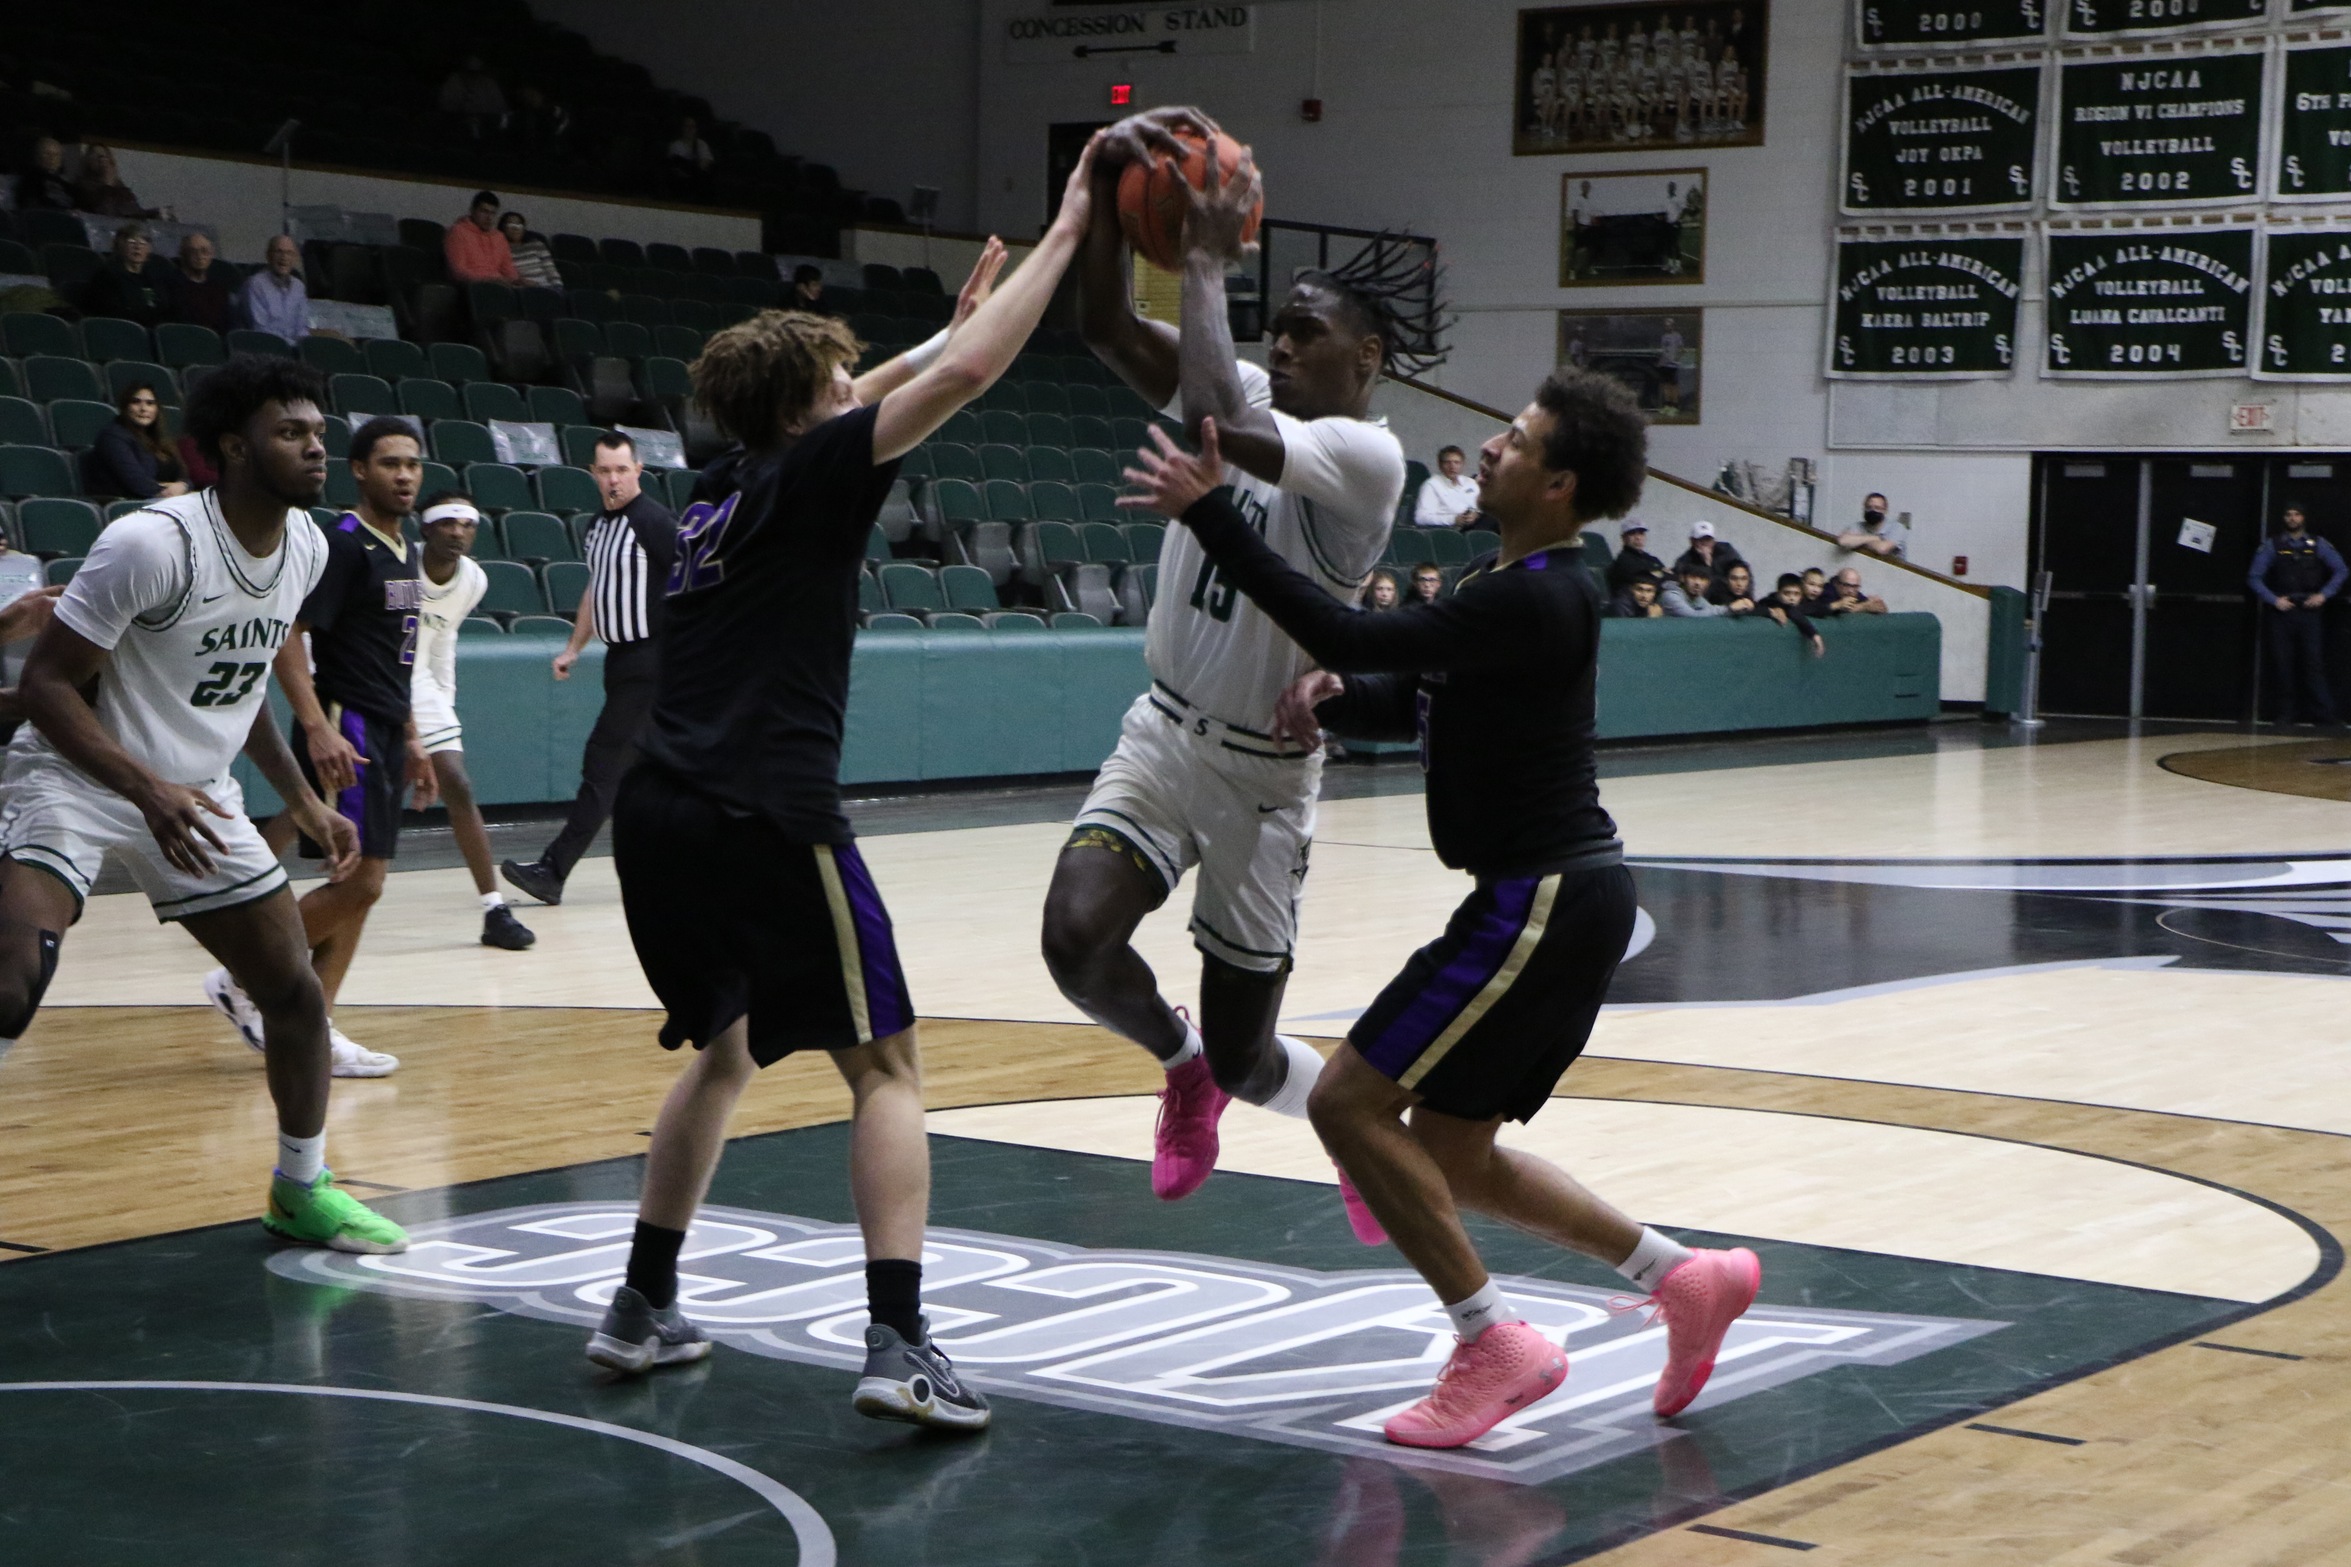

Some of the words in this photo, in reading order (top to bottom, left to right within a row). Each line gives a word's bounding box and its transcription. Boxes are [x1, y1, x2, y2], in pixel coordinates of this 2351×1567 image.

[1009, 13, 1145, 40] CONCESSION
[1165, 7, 1247, 31] STAND
[2120, 70, 2202, 91] NJCAA
[1855, 93, 1907, 133] NJCAA
[1911, 84, 2031, 124] ALL-AMERICAN
[2074, 105, 2130, 122] REGION
[2134, 104, 2153, 120] VI
[2157, 99, 2246, 119] CHAMPIONS
[1889, 116, 1993, 136] VOLLEYBALL
[1895, 147, 1930, 163] JOY
[1939, 146, 1984, 162] OKPA
[2100, 136, 2216, 156] VOLLEYBALL
[1904, 177, 1972, 197] 2001
[2120, 171, 2191, 191] 2002
[1839, 259, 1892, 302] NJCAA
[1898, 251, 2020, 299] ALL-AMERICAN
[2050, 255, 2108, 299] NJCAA
[2115, 245, 2250, 295] ALL-AMERICAN
[2270, 250, 2332, 297] NJCAA
[1876, 284, 1979, 301] VOLLEYBALL
[2094, 279, 2205, 296] VOLLEYBALL
[2127, 306, 2226, 324] CAVALCANTI
[1891, 345, 1955, 365] 2003
[2110, 343, 2181, 364] 2004
[664, 489, 743, 597] 32
[194, 617, 290, 657] SAINTS
[190, 661, 267, 707] 23
